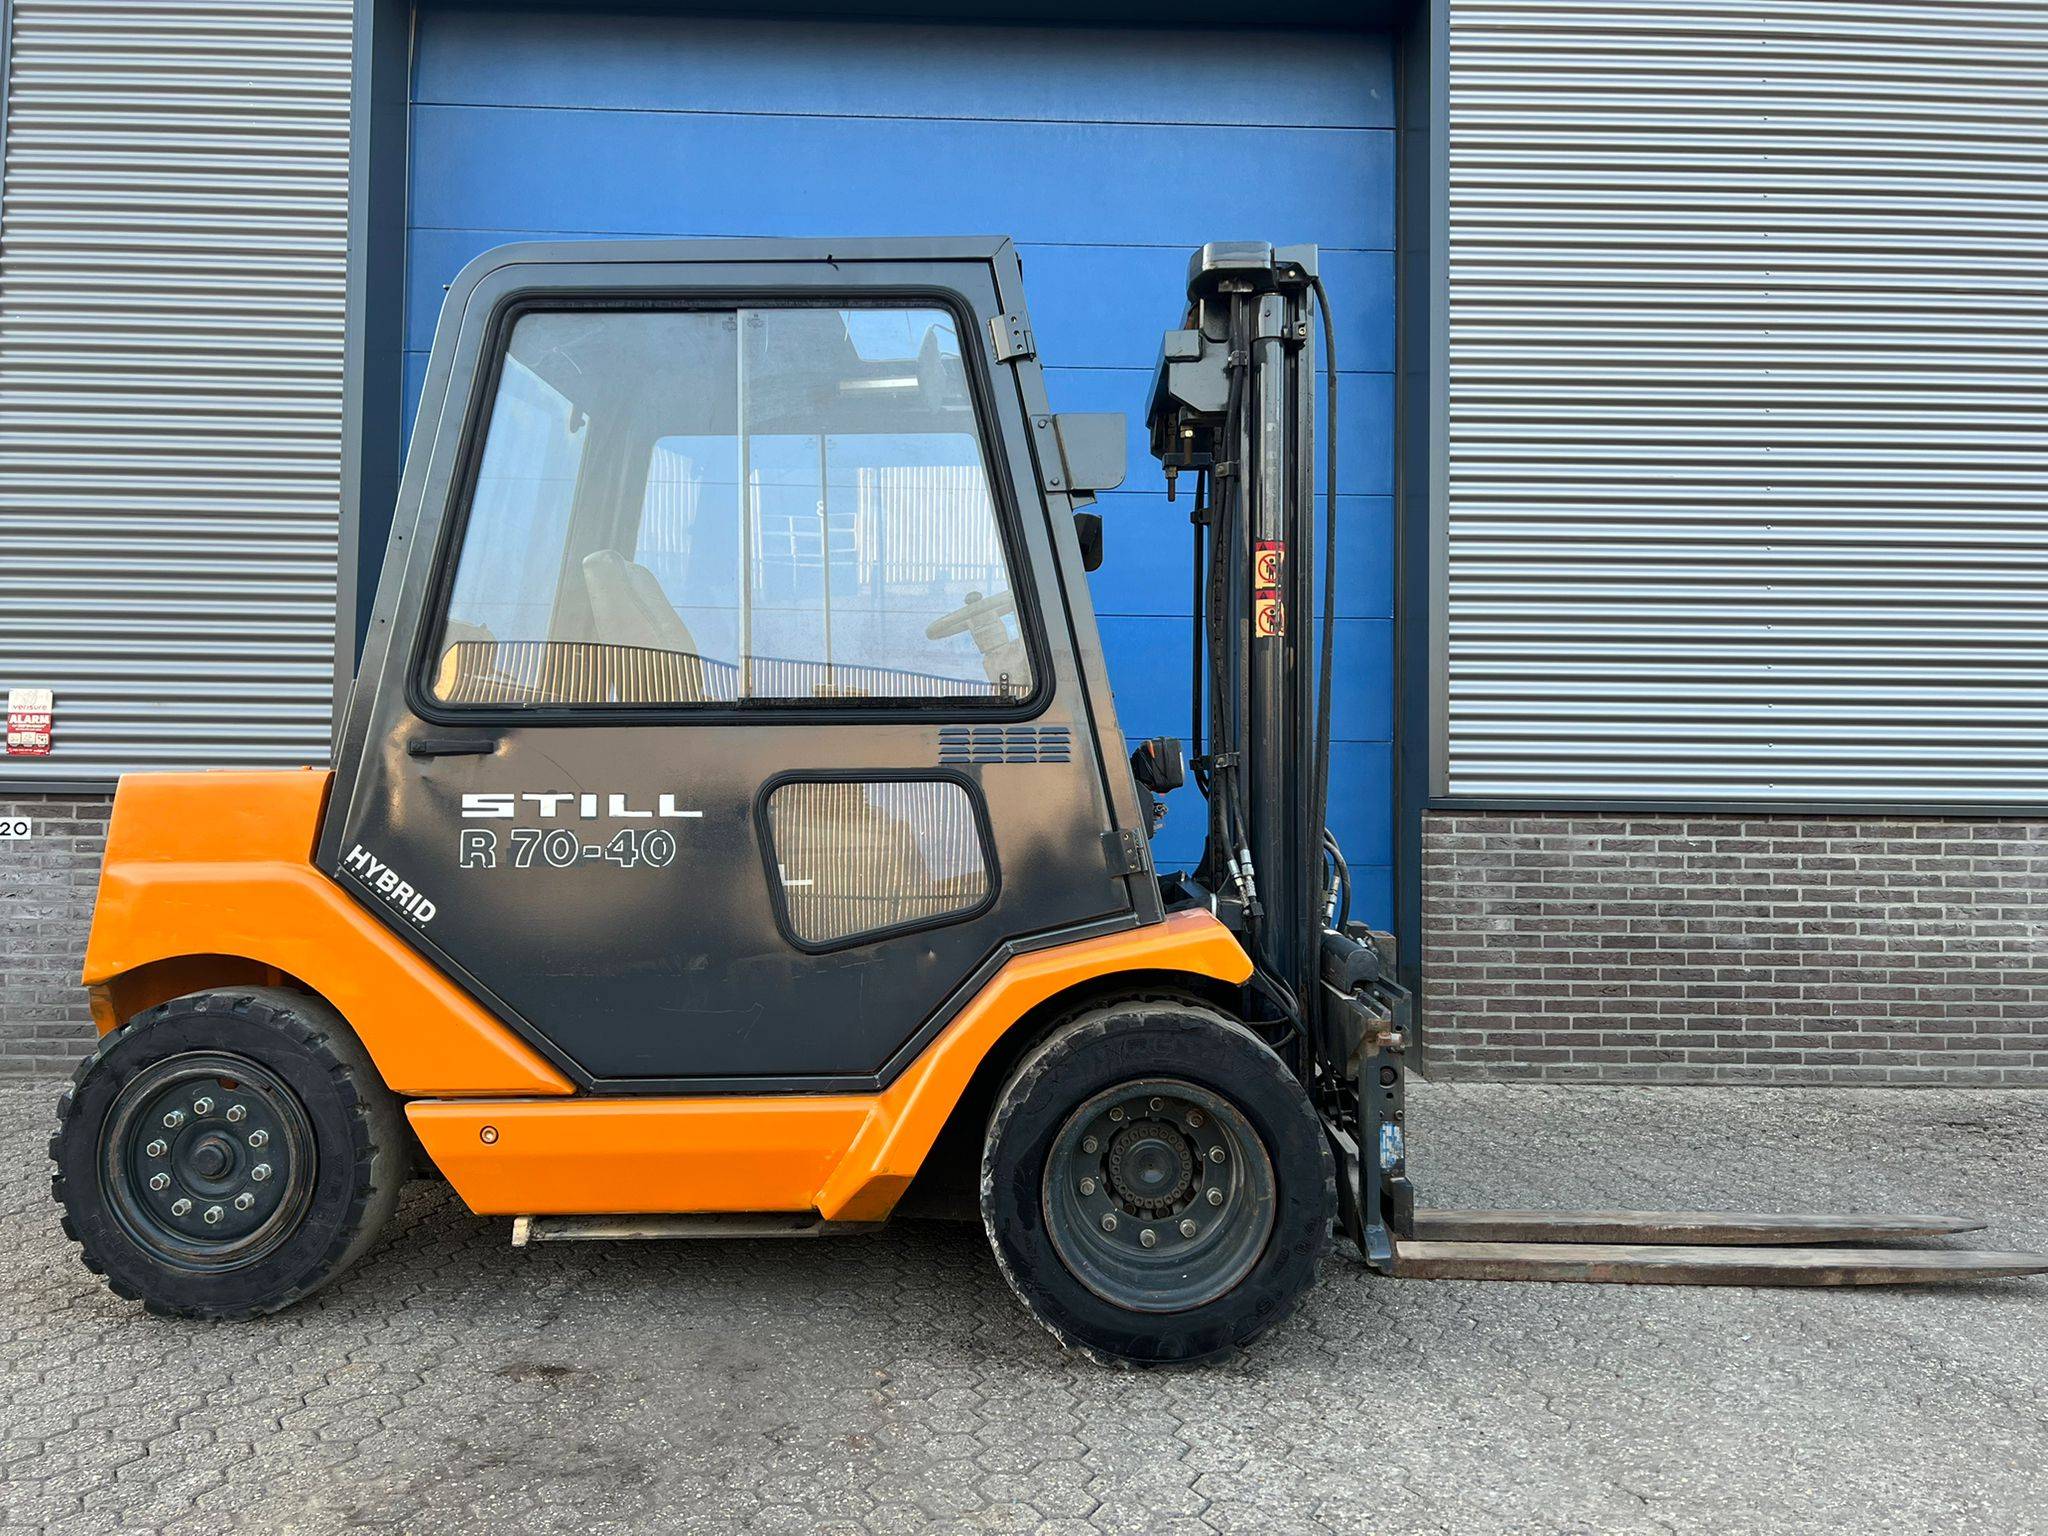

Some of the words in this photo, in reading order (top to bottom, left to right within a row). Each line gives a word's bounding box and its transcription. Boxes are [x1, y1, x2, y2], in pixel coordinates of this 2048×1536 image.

[9, 714, 50, 723] ALARM
[462, 793, 703, 817] STILL
[0, 822, 27, 836] 20
[459, 828, 496, 868] R
[510, 828, 676, 868] 70-40
[345, 843, 436, 922] HYBRID
